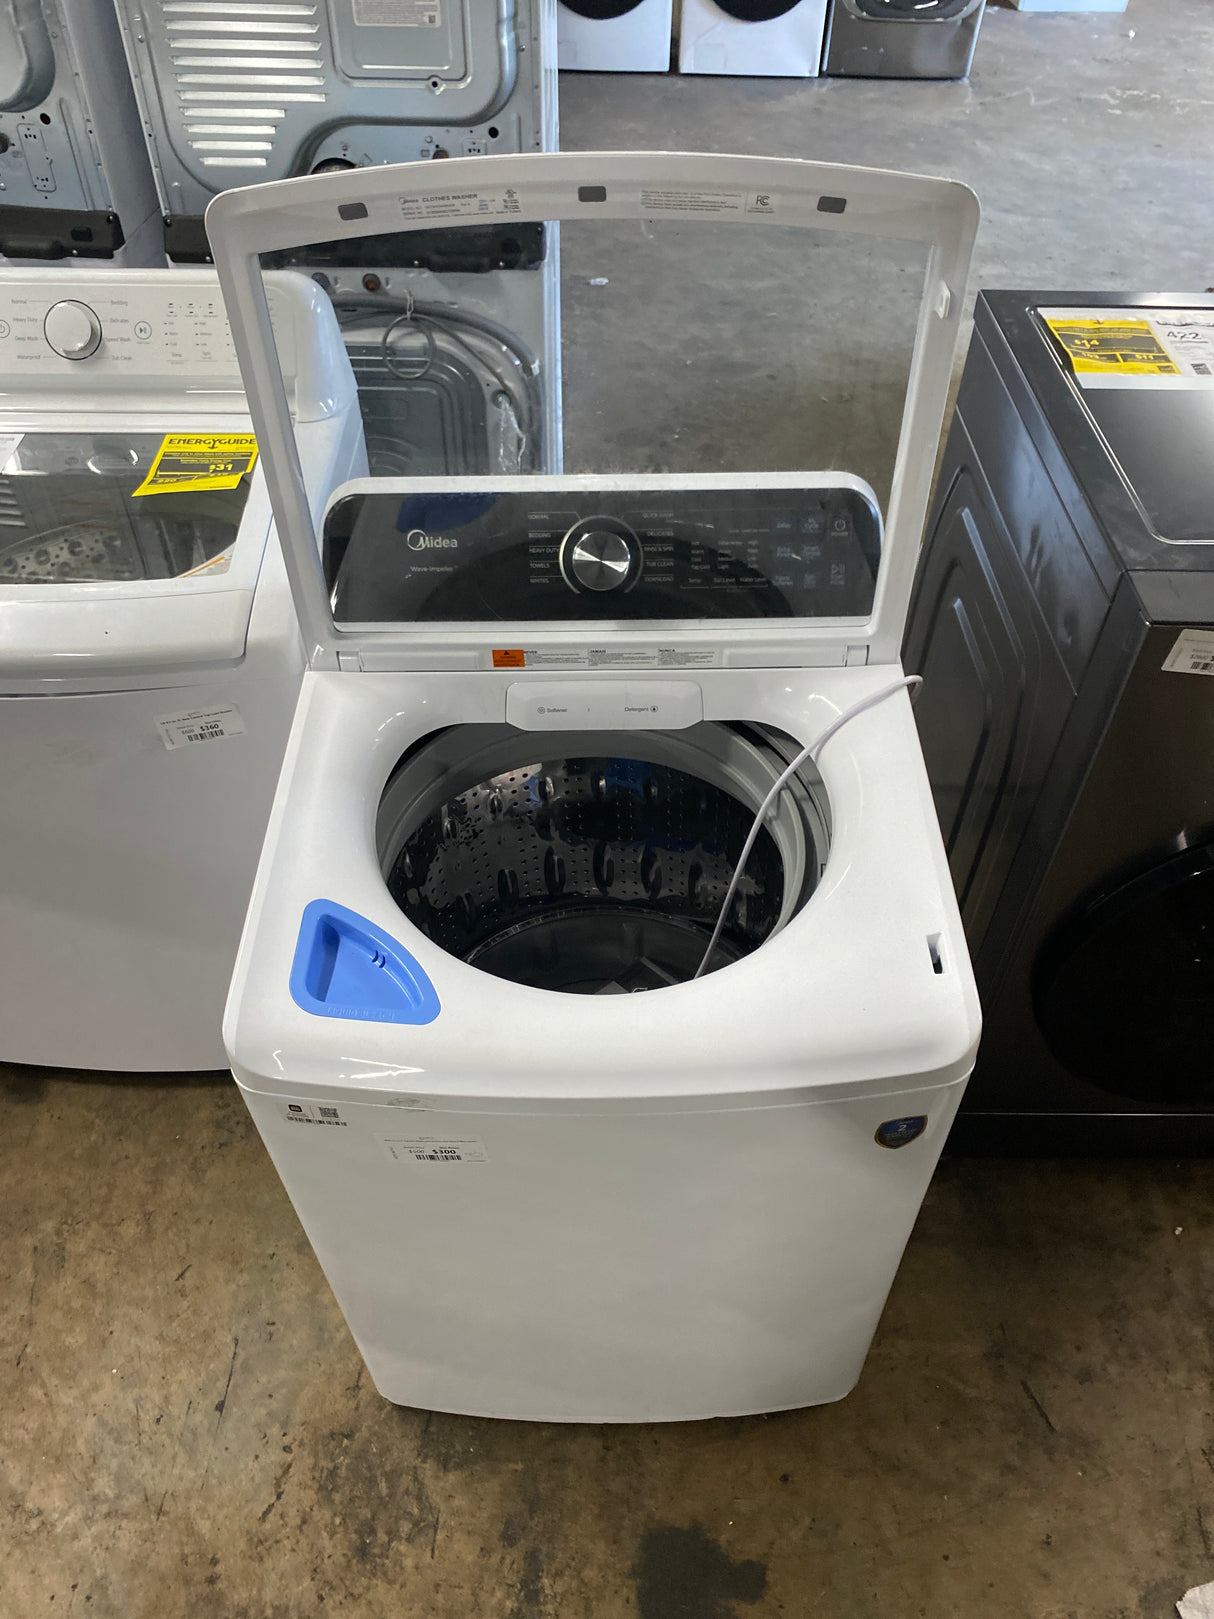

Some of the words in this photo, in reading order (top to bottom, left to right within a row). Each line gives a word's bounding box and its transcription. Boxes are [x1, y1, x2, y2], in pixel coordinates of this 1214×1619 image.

[168, 438, 257, 449] ENERGYGUIDE
[209, 463, 234, 472] $31
[407, 529, 458, 551] Midea
[200, 723, 220, 732] $360
